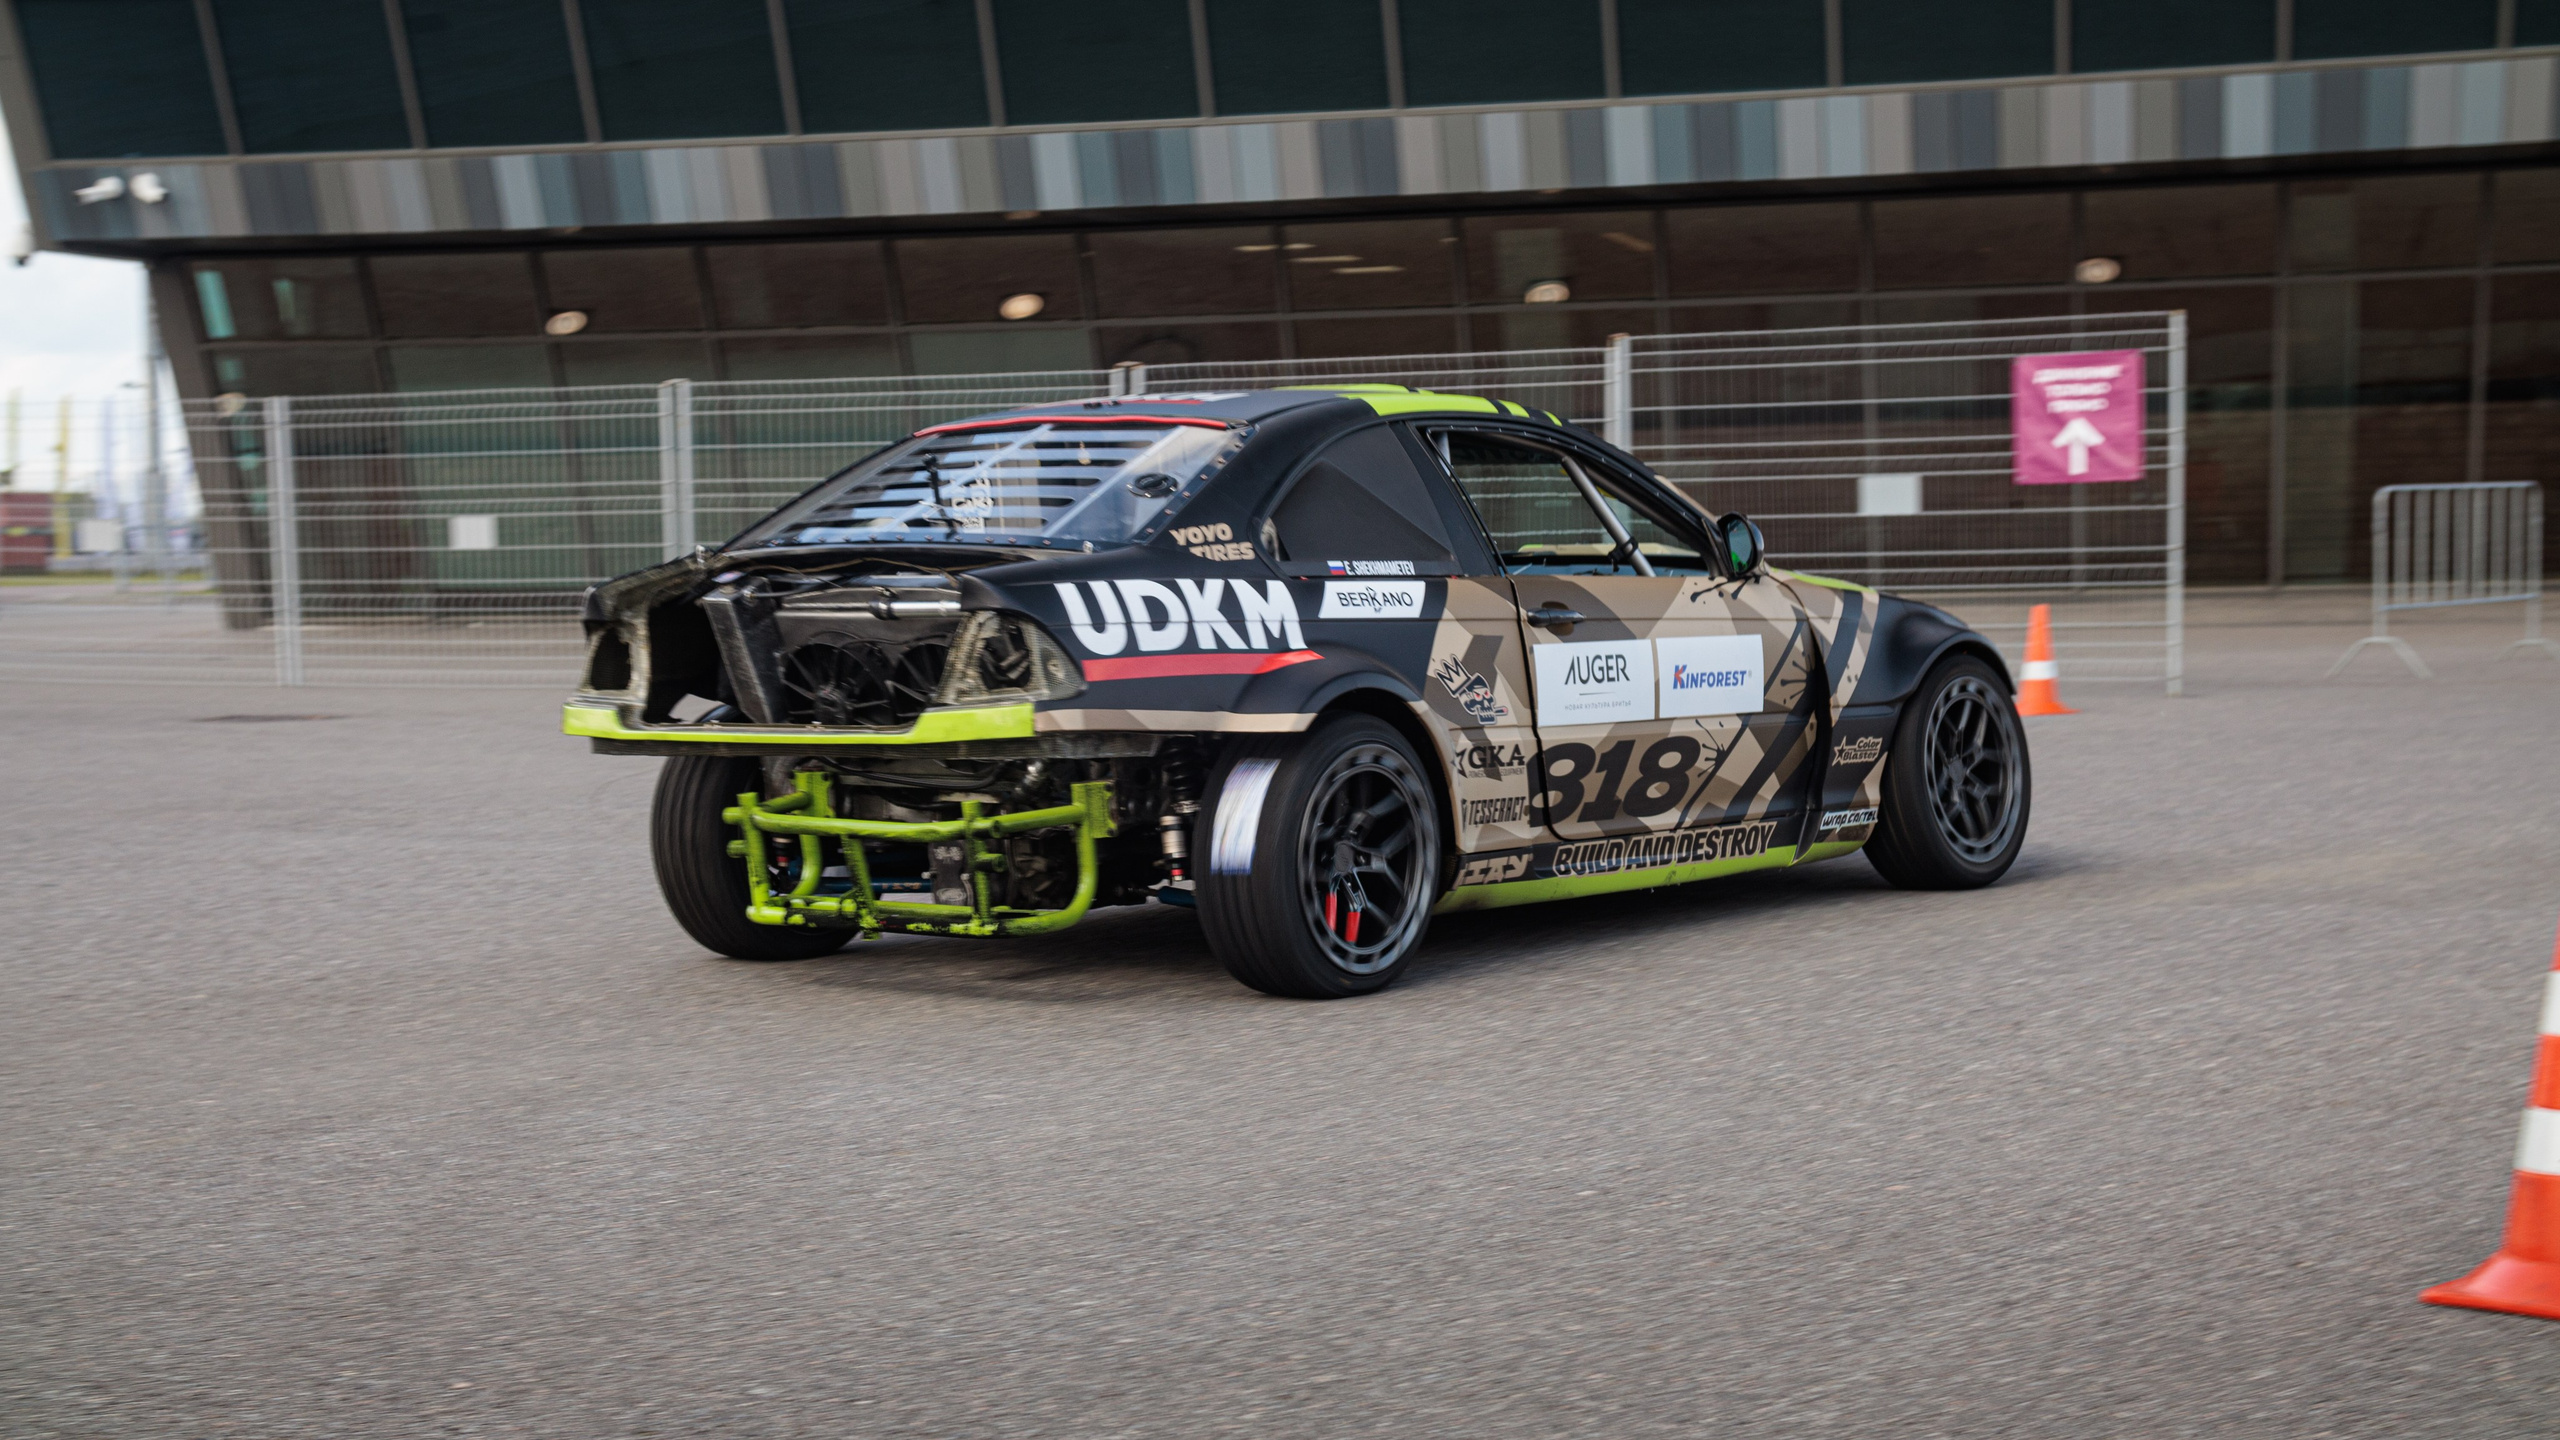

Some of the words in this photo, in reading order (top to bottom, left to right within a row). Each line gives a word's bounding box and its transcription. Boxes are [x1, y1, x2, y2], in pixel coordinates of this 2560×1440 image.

[1169, 522, 1233, 545] YOYO
[1189, 541, 1255, 561] TIRES
[1352, 560, 1415, 576] SHEKHMAMETEV
[1336, 587, 1414, 611] BERKANO
[1053, 578, 1309, 656] UDKM
[1564, 653, 1630, 685] AUGER
[1672, 664, 1747, 690] KINFOREST
[1468, 744, 1526, 769] GKA
[1843, 750, 1879, 761] Blaster
[1856, 739, 1880, 750] Color
[1526, 735, 1701, 828] 818
[1468, 796, 1527, 826] TESSERACT
[1552, 838, 1625, 878] BUILD
[1623, 831, 1677, 873] AND
[1674, 821, 1778, 865] DESTROY
